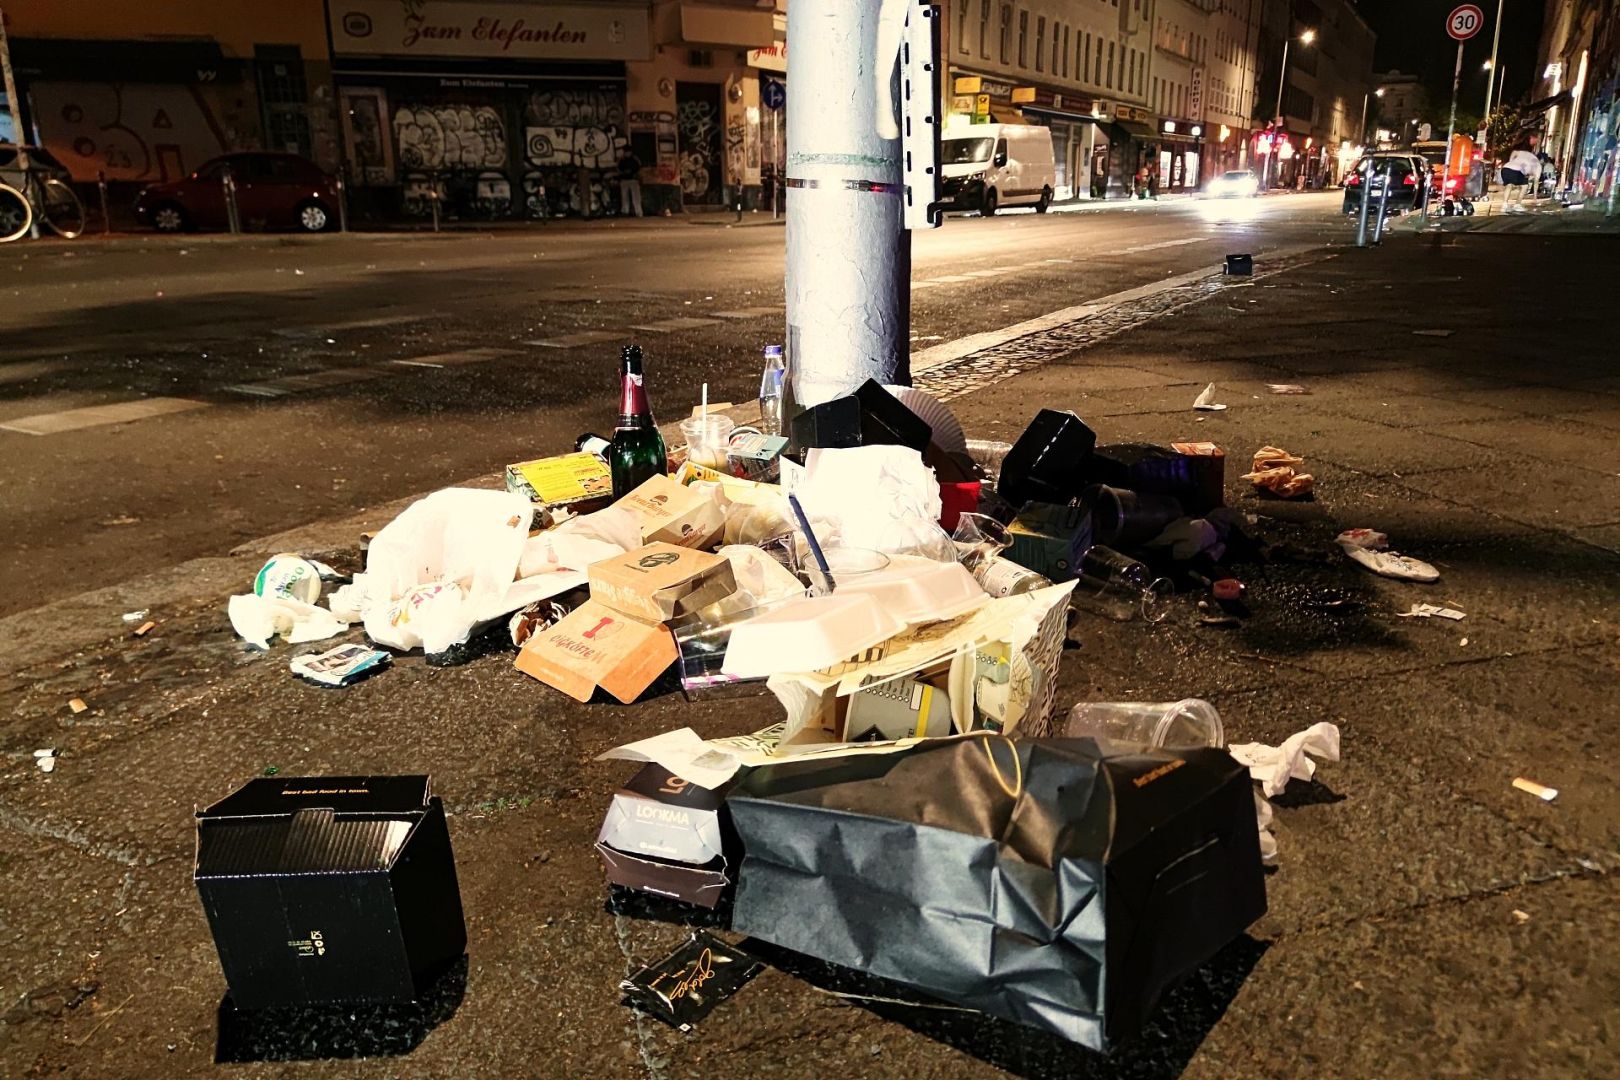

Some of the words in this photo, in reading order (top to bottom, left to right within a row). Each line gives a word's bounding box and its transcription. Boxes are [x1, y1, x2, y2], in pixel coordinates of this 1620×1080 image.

[402, 13, 461, 46] Zum
[471, 17, 586, 50] Elefanten
[1455, 15, 1475, 30] 30
